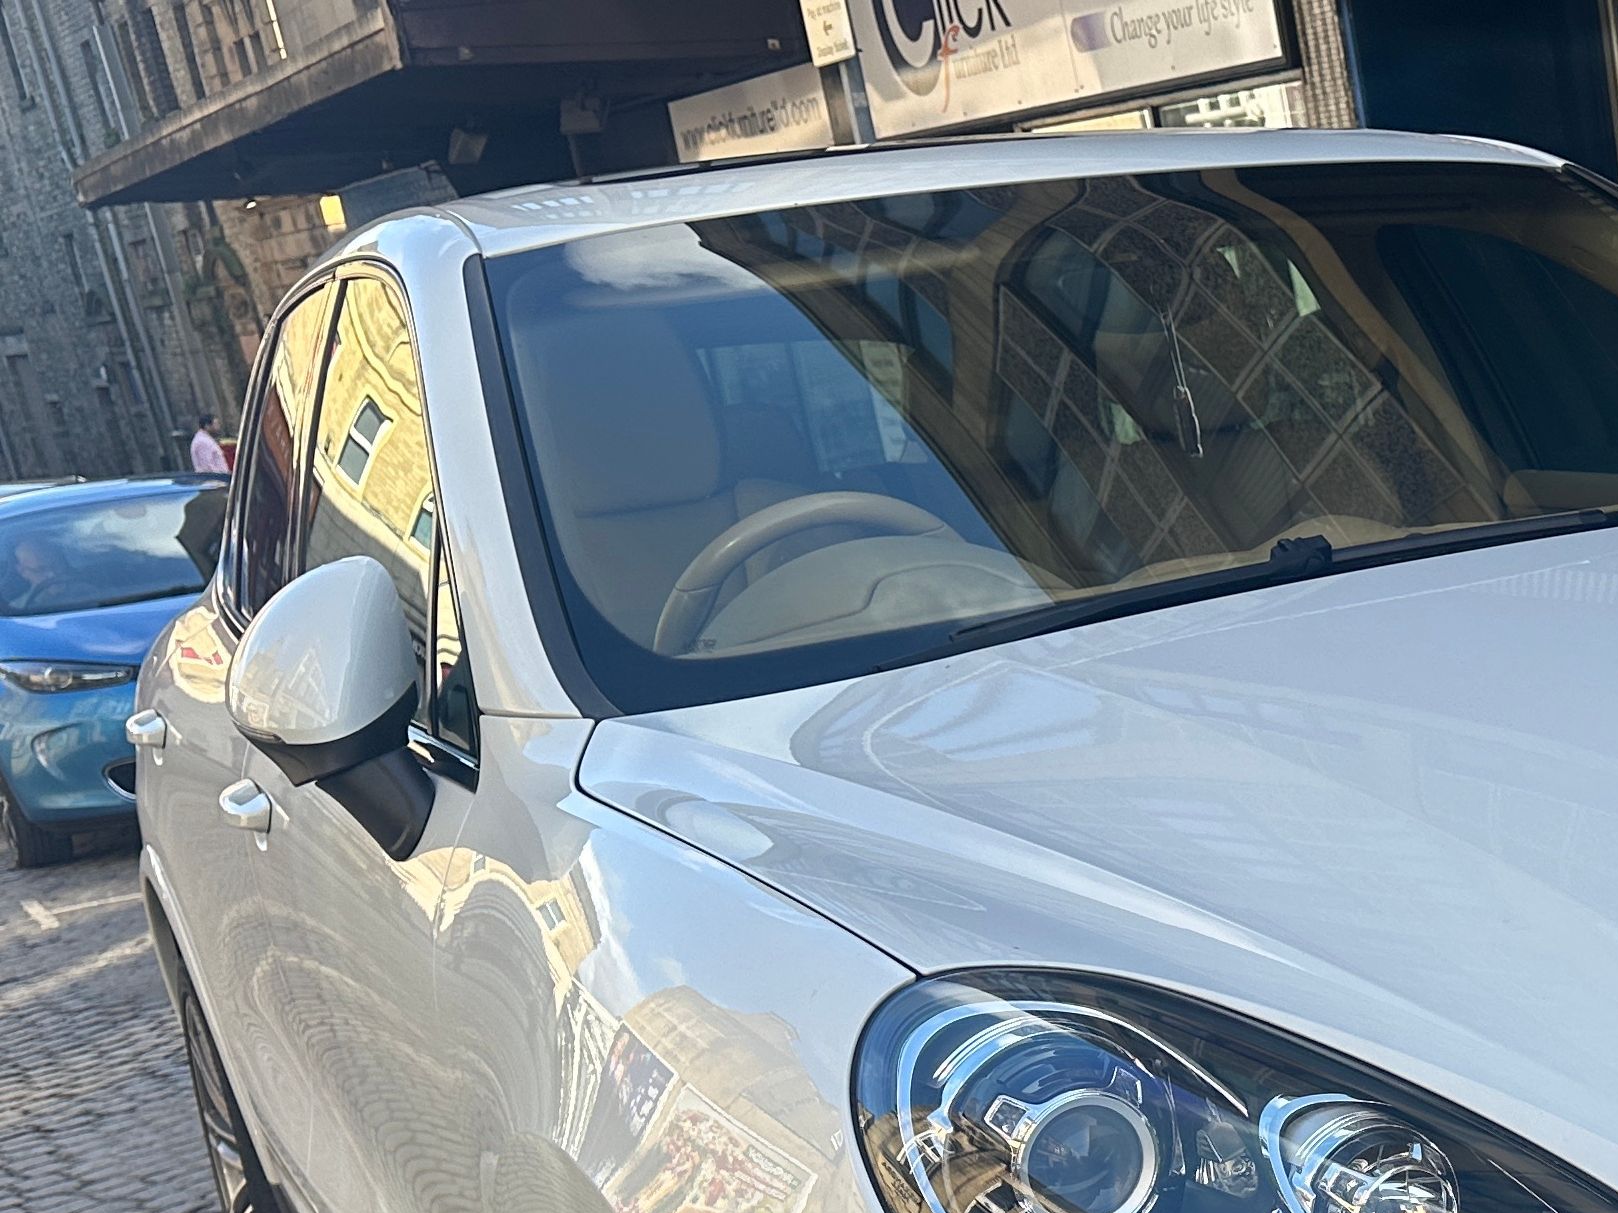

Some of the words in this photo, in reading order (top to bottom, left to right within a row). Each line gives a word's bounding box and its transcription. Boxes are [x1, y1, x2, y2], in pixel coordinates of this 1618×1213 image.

[1110, 6, 1161, 48] Change
[1161, 4, 1194, 44] your
[1196, 0, 1219, 36] life
